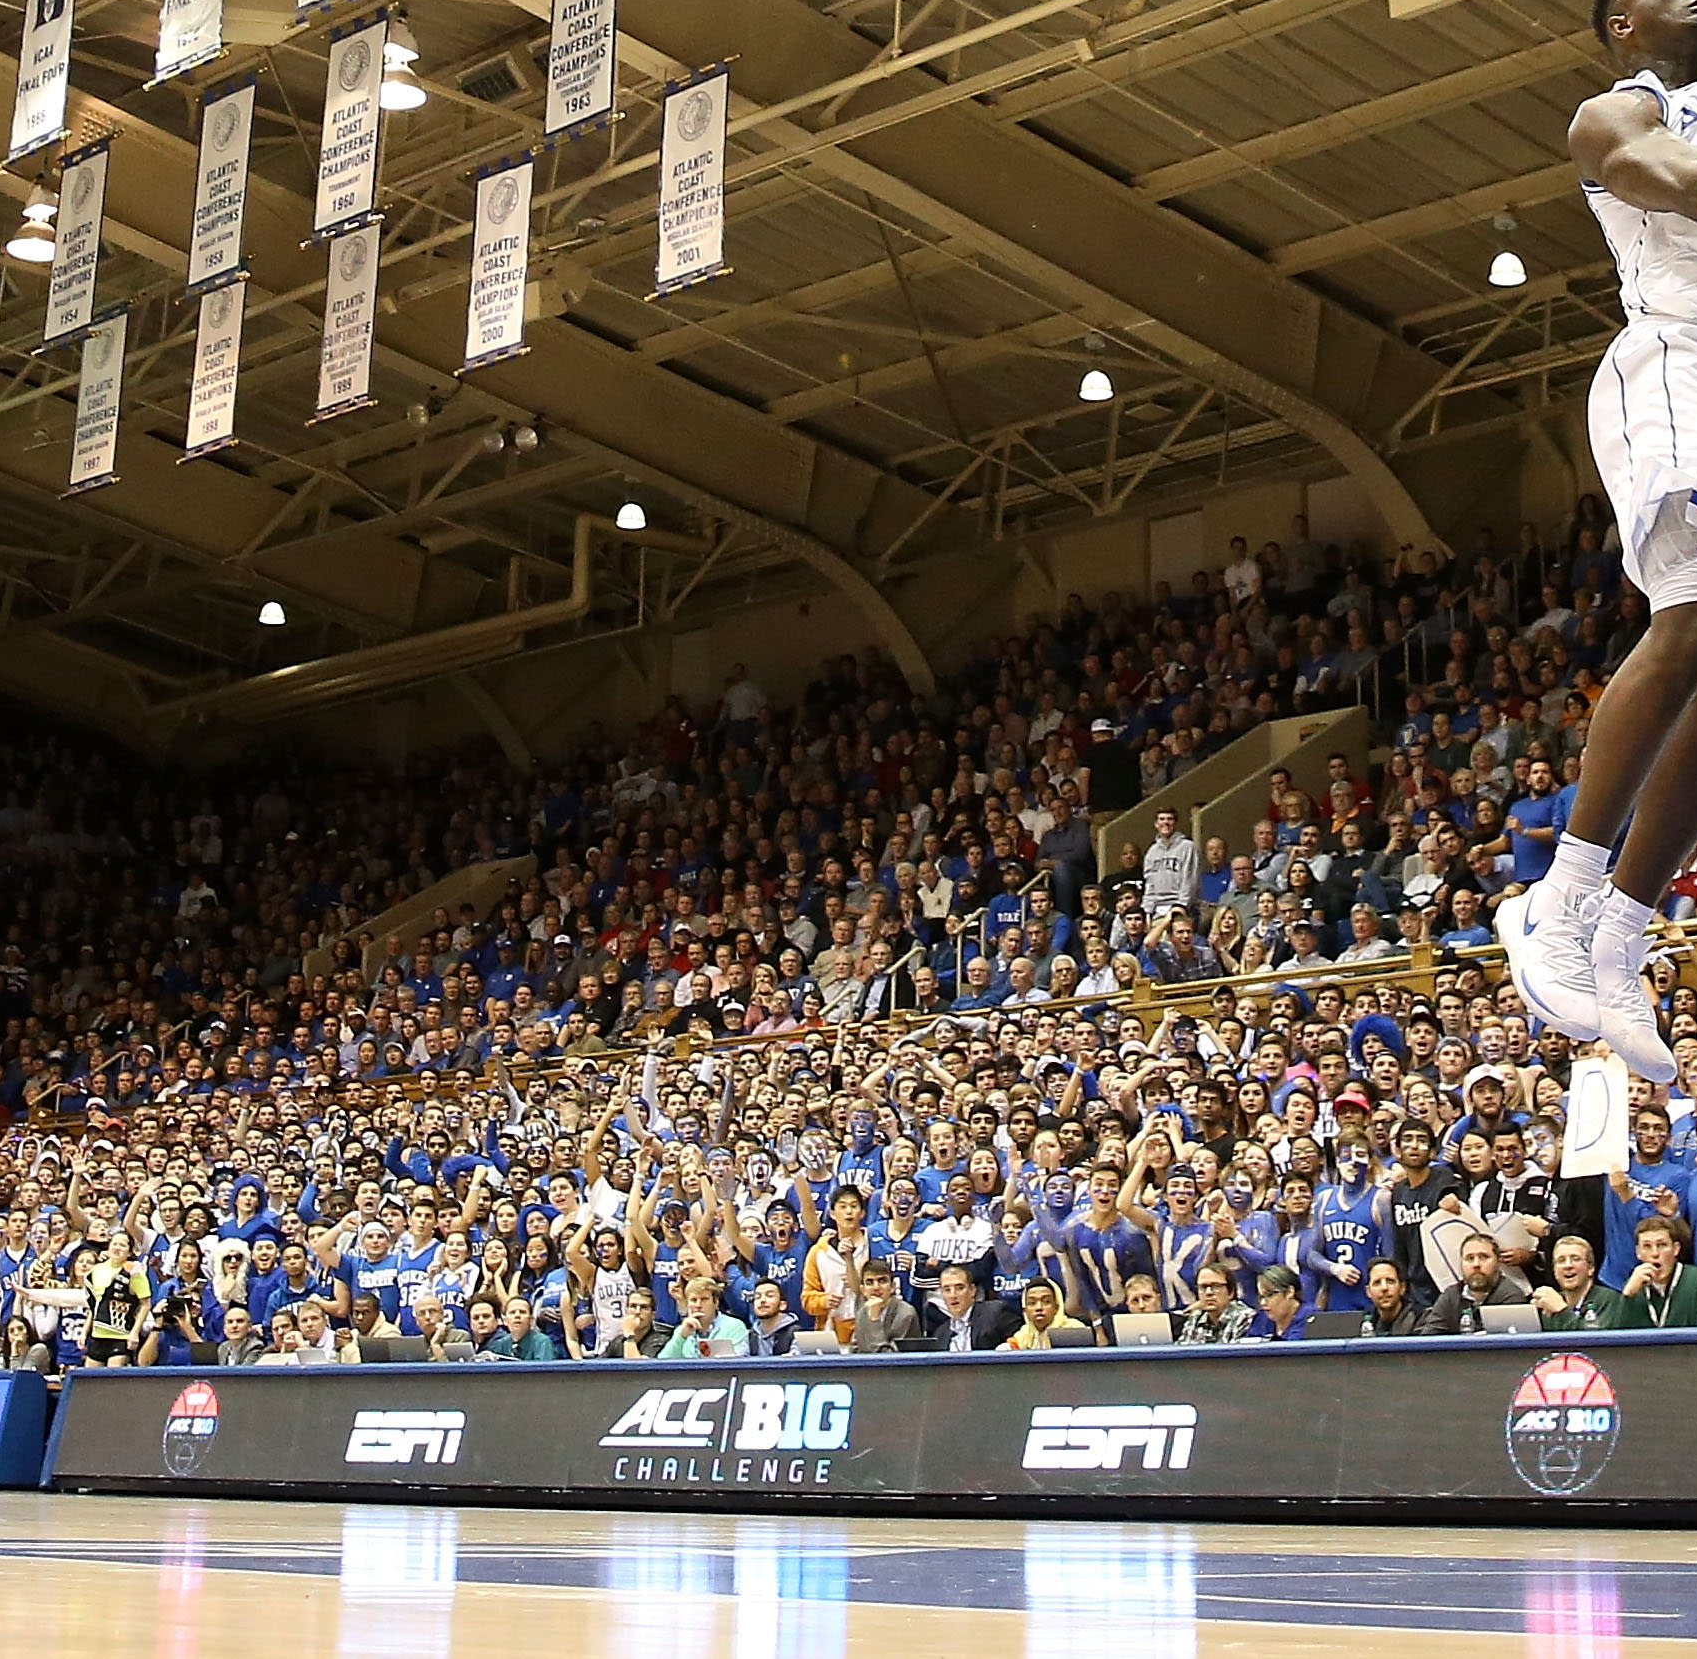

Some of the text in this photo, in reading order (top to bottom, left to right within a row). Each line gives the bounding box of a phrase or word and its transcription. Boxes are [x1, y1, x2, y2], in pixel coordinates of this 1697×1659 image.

[550, 23, 611, 62] CONFERENCE
[677, 246, 701, 266] 2001
[1323, 1221, 1370, 1245] DUKE
[608, 1388, 728, 1436] ACC
[345, 1410, 467, 1464] ESPN
[1022, 1405, 1197, 1471] ESPN
[614, 1456, 832, 1484] CHALLENGE
